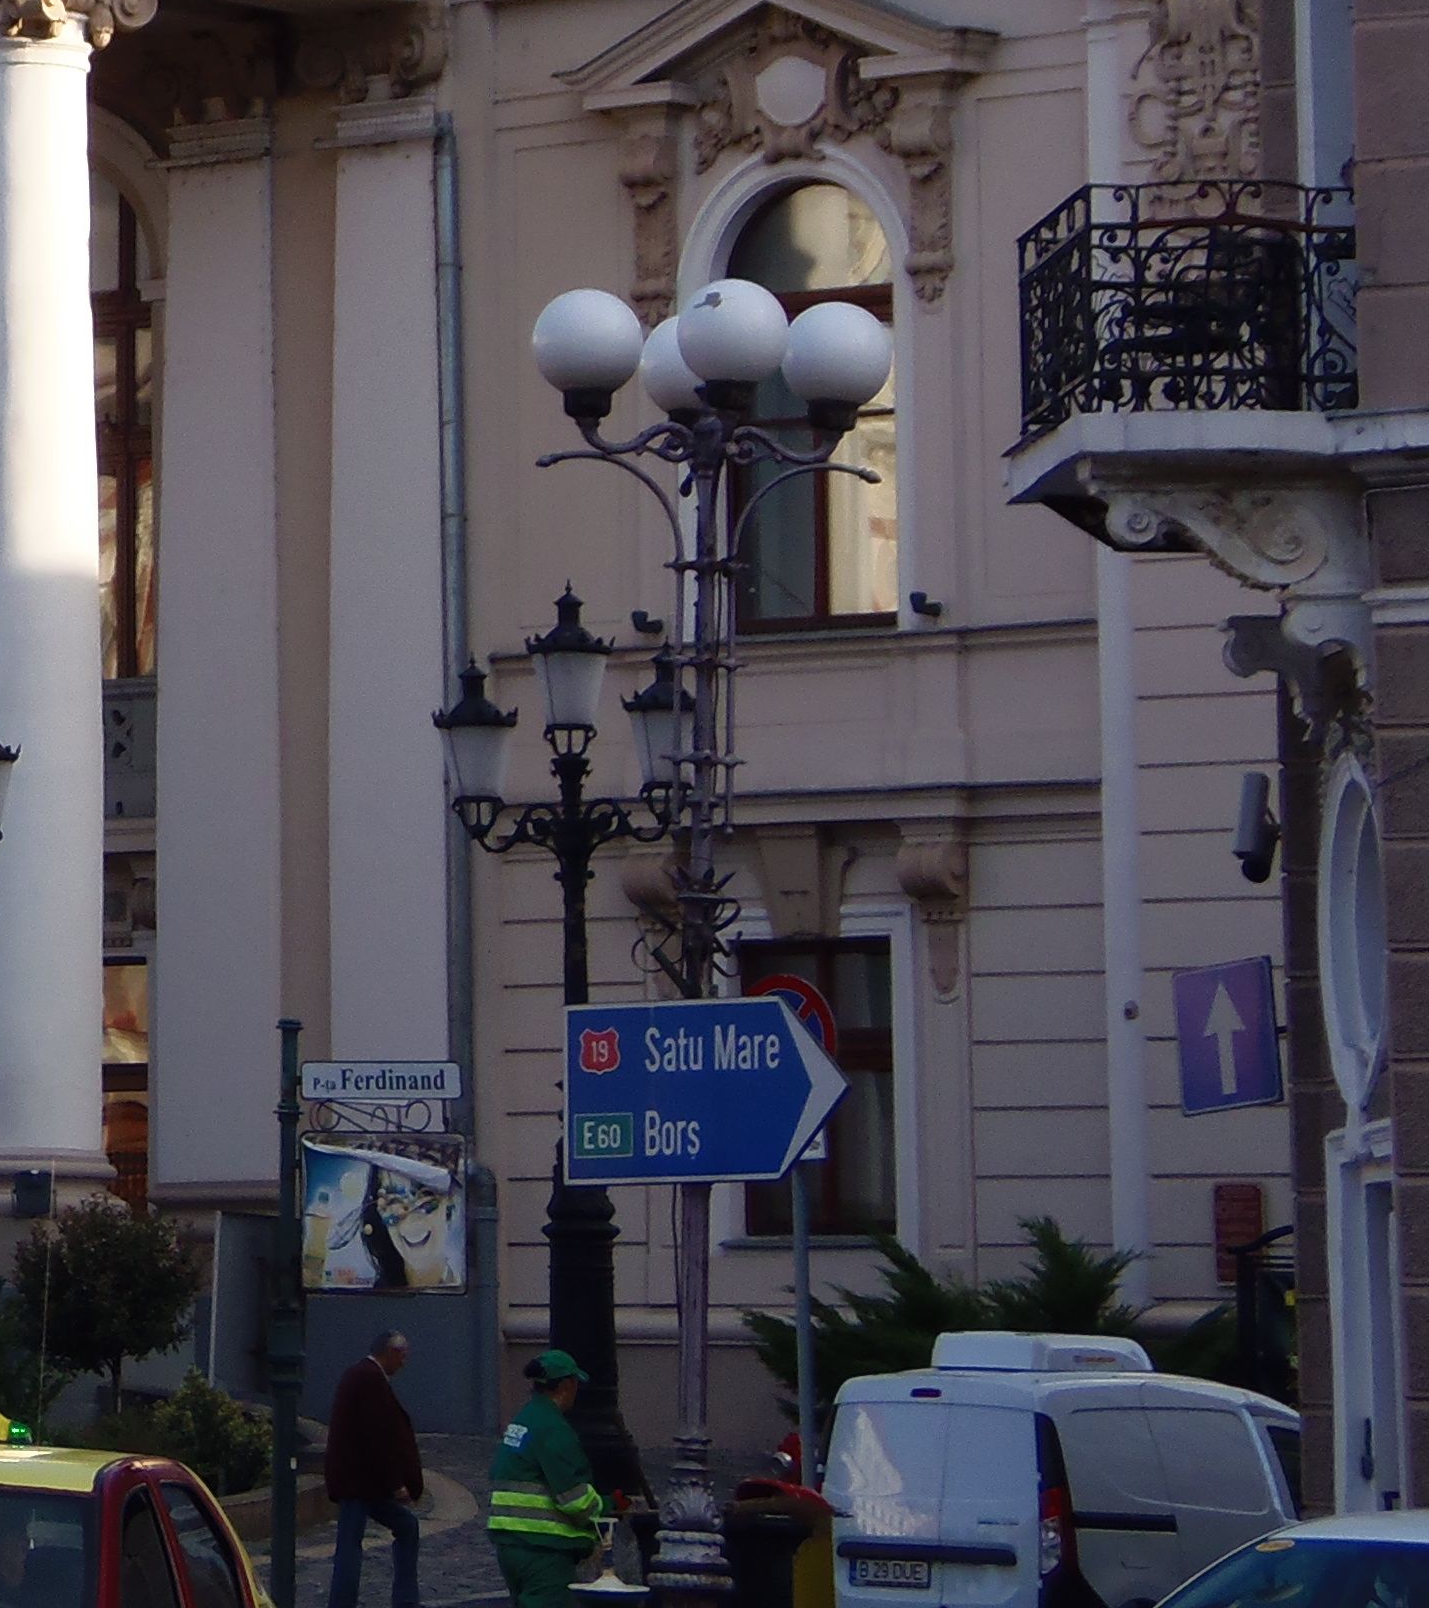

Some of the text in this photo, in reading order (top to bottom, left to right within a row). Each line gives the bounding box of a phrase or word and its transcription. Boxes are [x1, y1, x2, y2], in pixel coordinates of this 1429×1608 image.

[591, 1024, 780, 1072] 19 Satu Mare
[341, 1068, 445, 1091] Ferdinand
